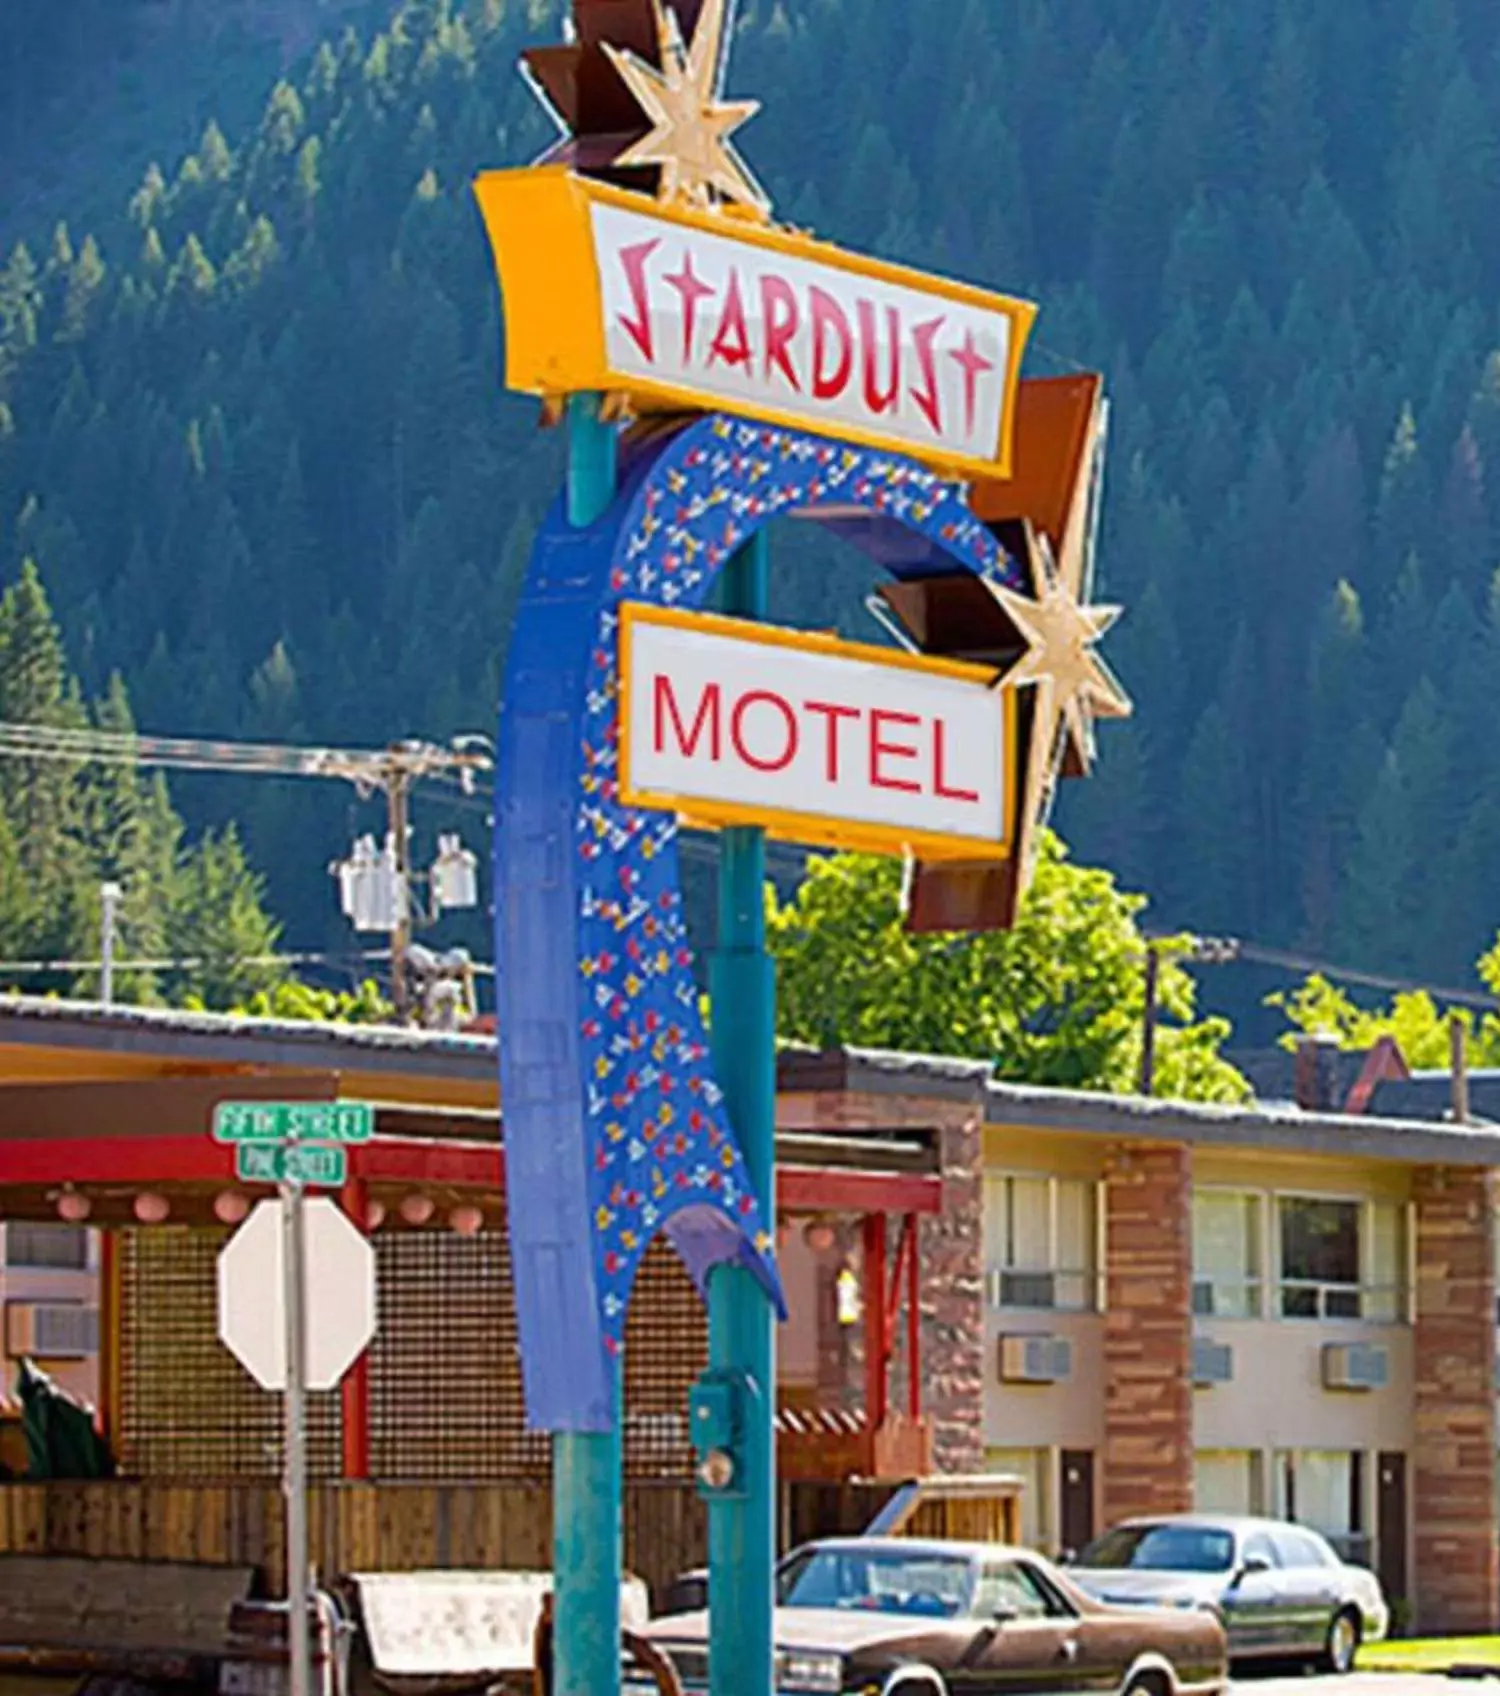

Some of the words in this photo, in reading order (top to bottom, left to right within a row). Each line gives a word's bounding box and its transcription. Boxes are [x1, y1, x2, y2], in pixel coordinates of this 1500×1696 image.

[616, 237, 994, 440] STARDUST
[652, 674, 979, 803] MOTEL
[287, 1104, 365, 1138] STREET
